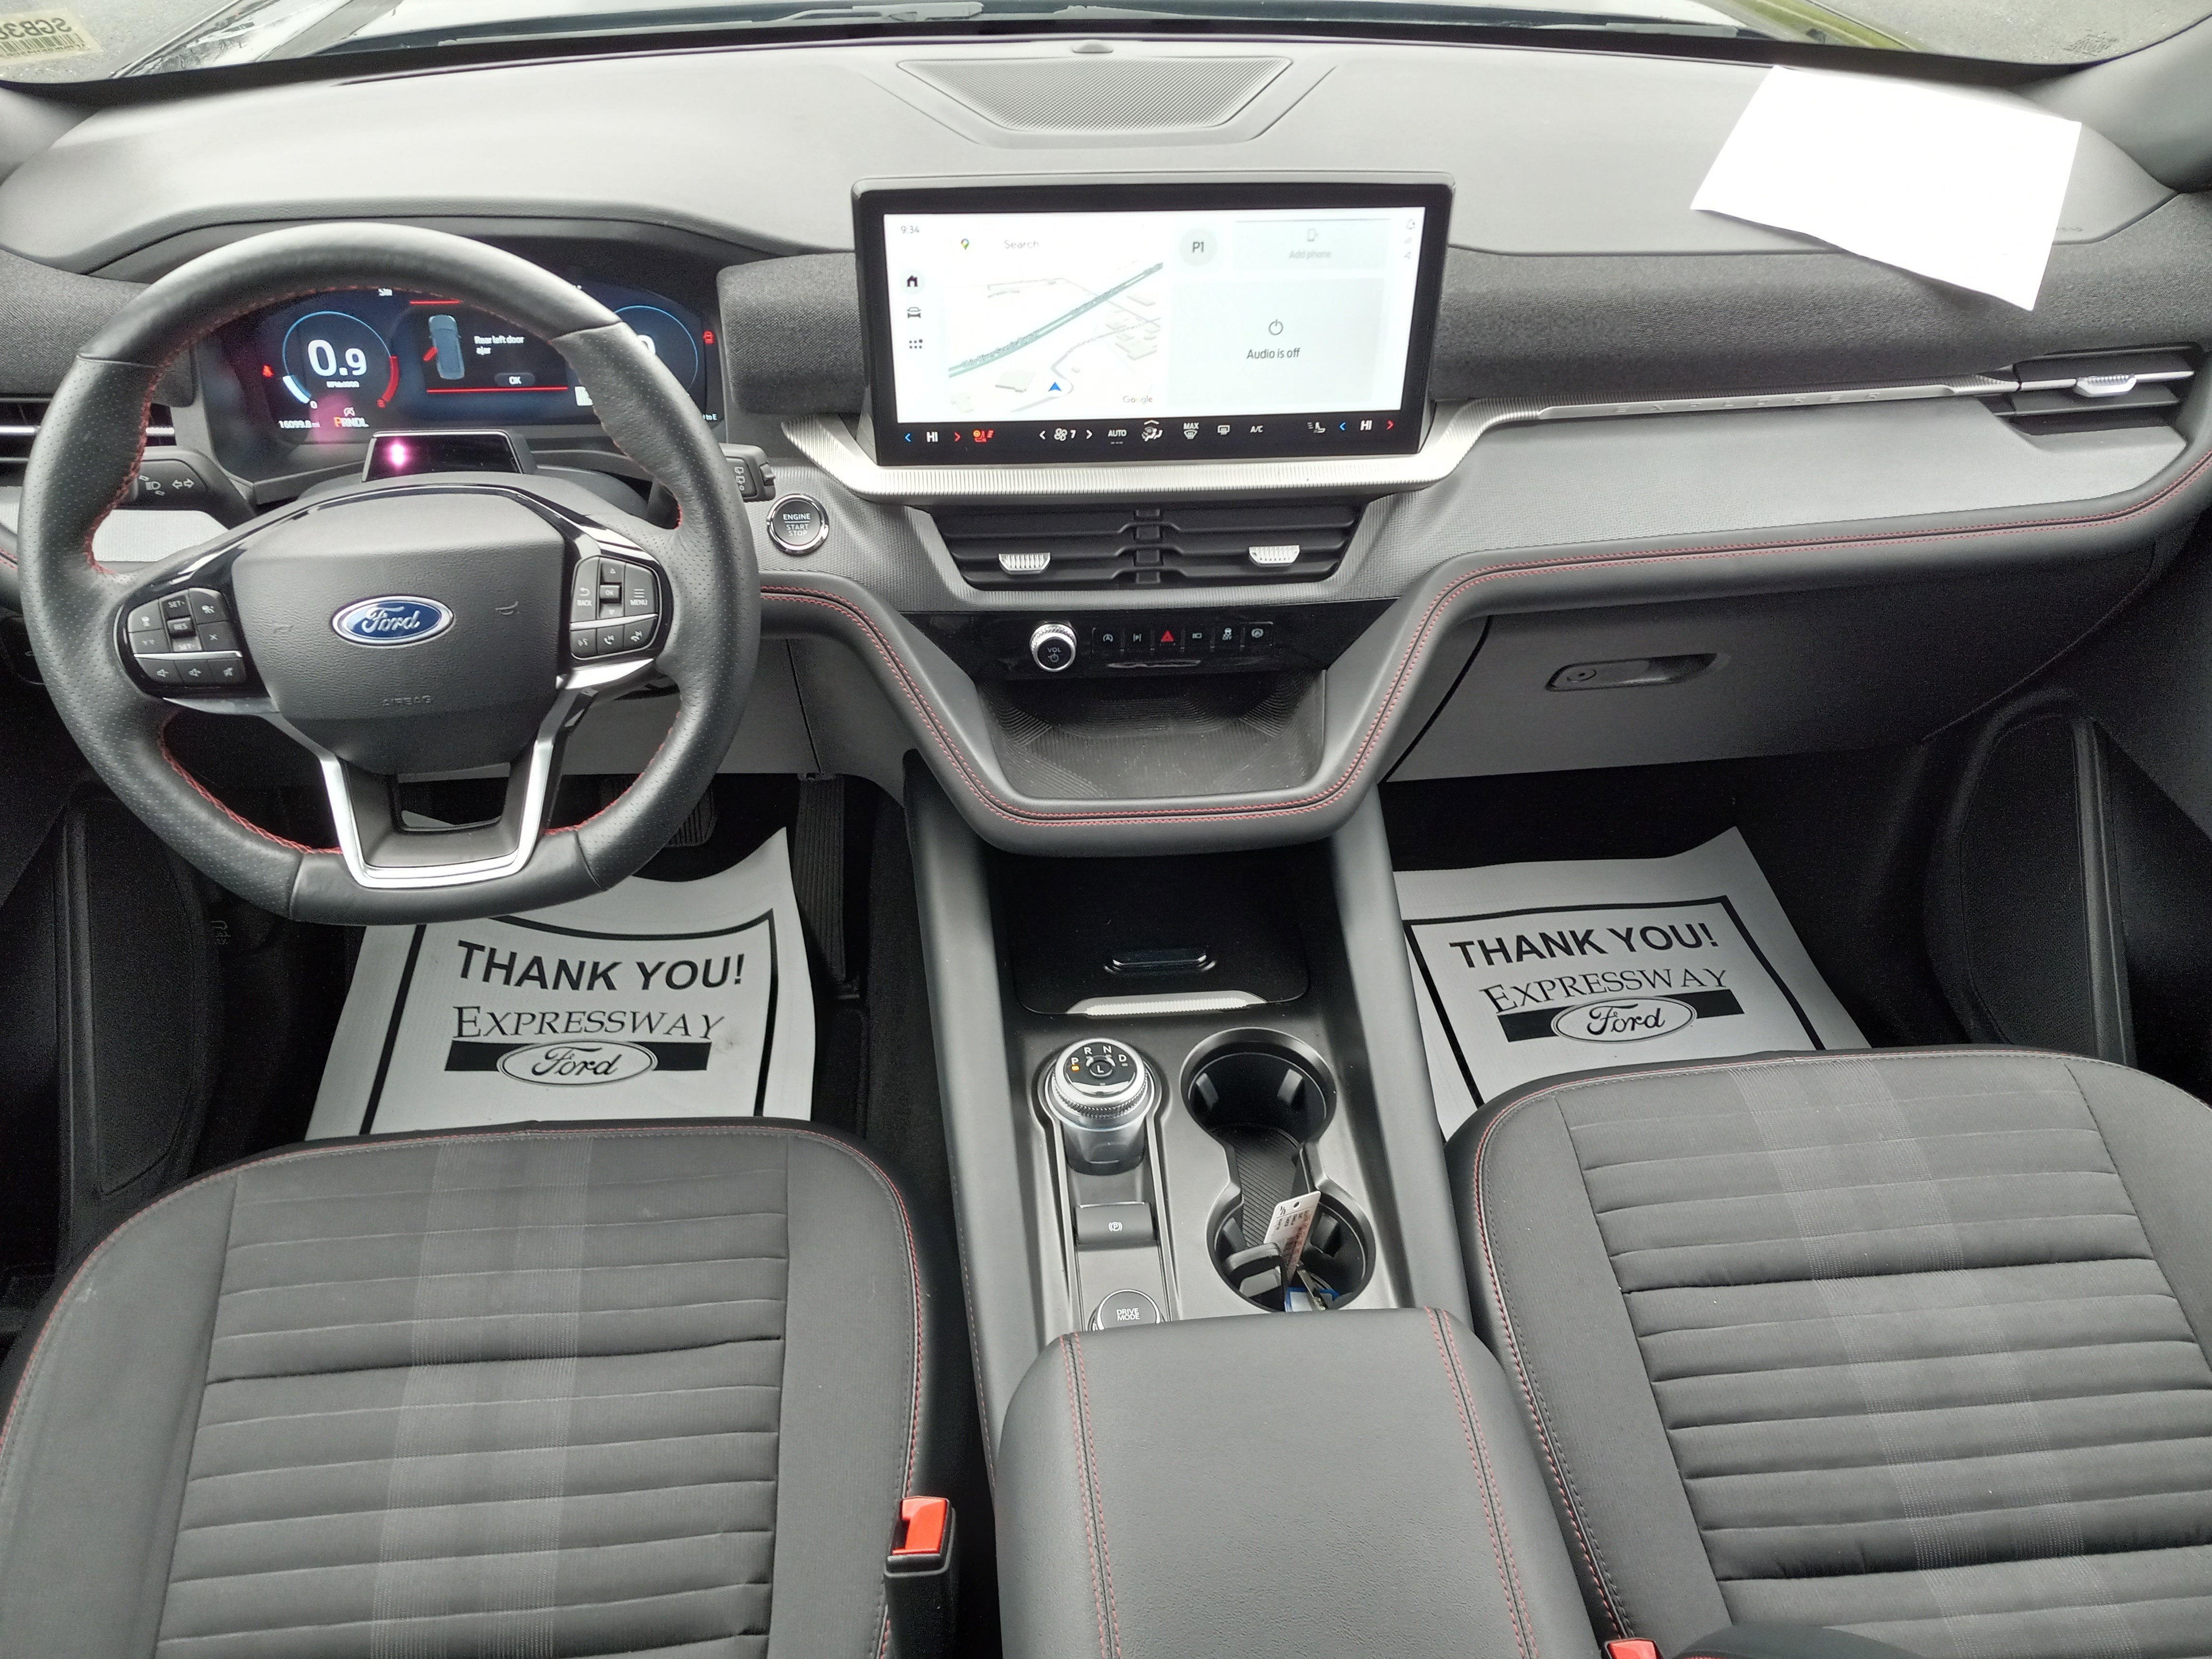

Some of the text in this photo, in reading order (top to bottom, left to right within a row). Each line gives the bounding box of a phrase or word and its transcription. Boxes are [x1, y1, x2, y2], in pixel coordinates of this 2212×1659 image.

[901, 225, 920, 234] 9:34
[1004, 240, 1040, 249] Search
[1191, 241, 1205, 253] P1
[1289, 250, 1332, 260] Add phone
[474, 335, 525, 344] Rear left door
[476, 346, 492, 355] ajar
[1246, 347, 1301, 360] Audio is off
[308, 339, 367, 377] 0.9
[509, 376, 522, 385] OK
[1123, 395, 1153, 404] Google
[1250, 425, 1263, 433] A/C
[1360, 420, 1372, 431] HI
[926, 432, 938, 443] HI
[1070, 429, 1076, 439] 7
[1108, 429, 1127, 437] AUTO
[783, 513, 811, 521] ENGINE
[361, 606, 421, 633] Ford
[1449, 922, 1719, 969] THANK YOU!
[457, 939, 745, 991] THANK YOU!
[1479, 968, 1727, 1014] EXPRESSWAY
[452, 1006, 725, 1041] EXPRESSWAY
[1586, 1003, 1666, 1035] Ford
[1071, 1046, 1127, 1065] P R N D
[530, 1046, 623, 1078] Ford
[1117, 1308, 1139, 1316] DRIVE
